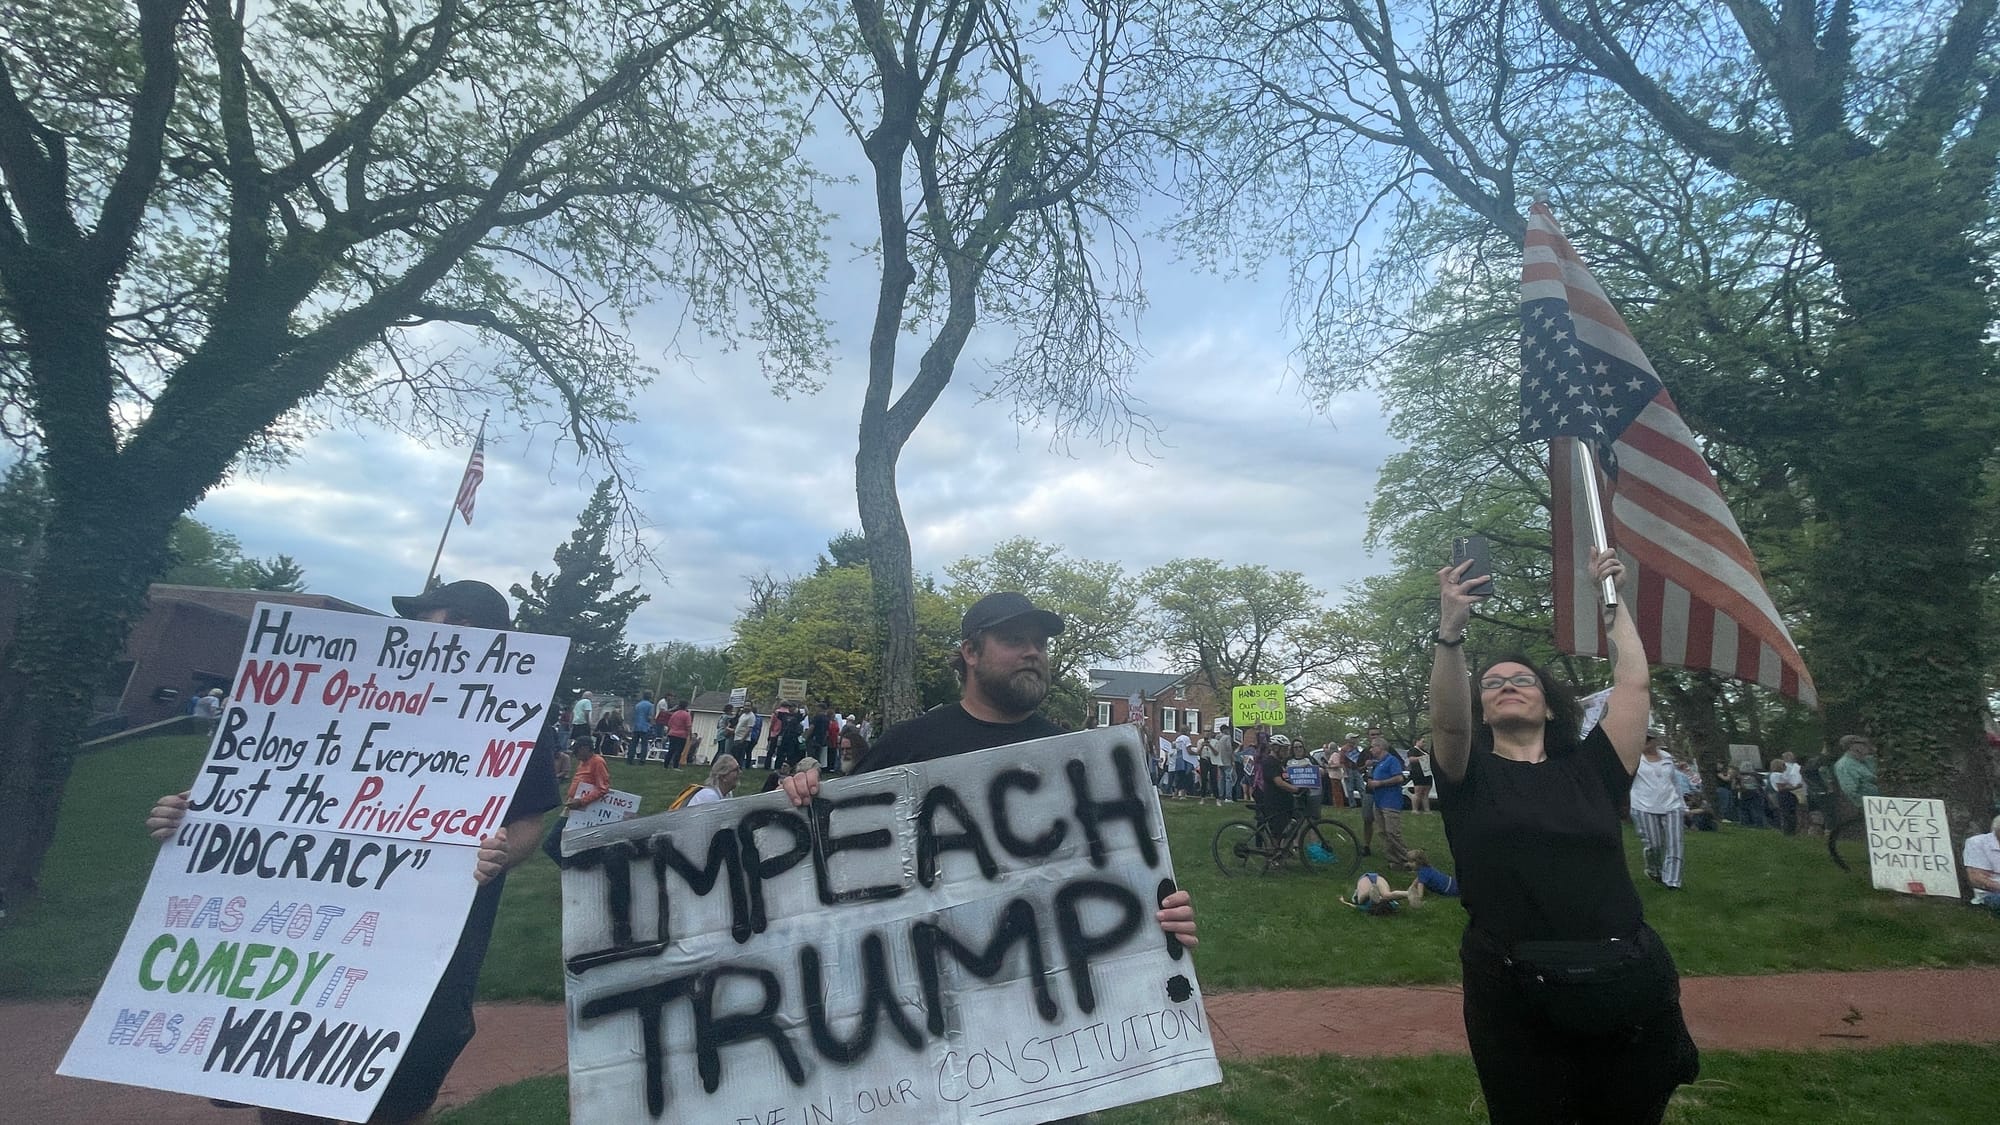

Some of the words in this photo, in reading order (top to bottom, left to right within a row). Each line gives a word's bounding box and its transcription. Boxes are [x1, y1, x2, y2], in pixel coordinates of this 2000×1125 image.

[250, 608, 357, 662] Human
[377, 625, 471, 680] Rights
[479, 632, 536, 675] Are
[234, 660, 322, 705] NOT
[1238, 689, 1260, 699] HANDS
[1242, 710, 1283, 721] MEDICAID
[214, 707, 308, 772] Belong
[315, 720, 342, 767] to
[353, 722, 471, 779] Everyone,
[476, 739, 536, 780] NOT
[189, 766, 271, 819] Just
[280, 773, 339, 825] the
[340, 775, 507, 842] Privileged!
[598, 809, 612, 818] IN
[601, 795, 633, 809] KINGS
[1868, 799, 1934, 817] NAZI
[1870, 817, 1940, 835] LIVES
[560, 744, 1161, 975] IMPEACH
[1873, 852, 1952, 873] MATTER
[166, 895, 246, 933] WAS
[251, 900, 346, 941] NOT
[342, 910, 380, 947] A
[139, 933, 335, 1006] COMEDY
[316, 966, 369, 1010] IT
[110, 1008, 184, 1054] WAS
[179, 1015, 216, 1055] A
[203, 1006, 402, 1092] WARNING
[803, 1096, 834, 1125] IN
[857, 1079, 921, 1113] OUR
[938, 1003, 1203, 1102] CONSTITUTION
